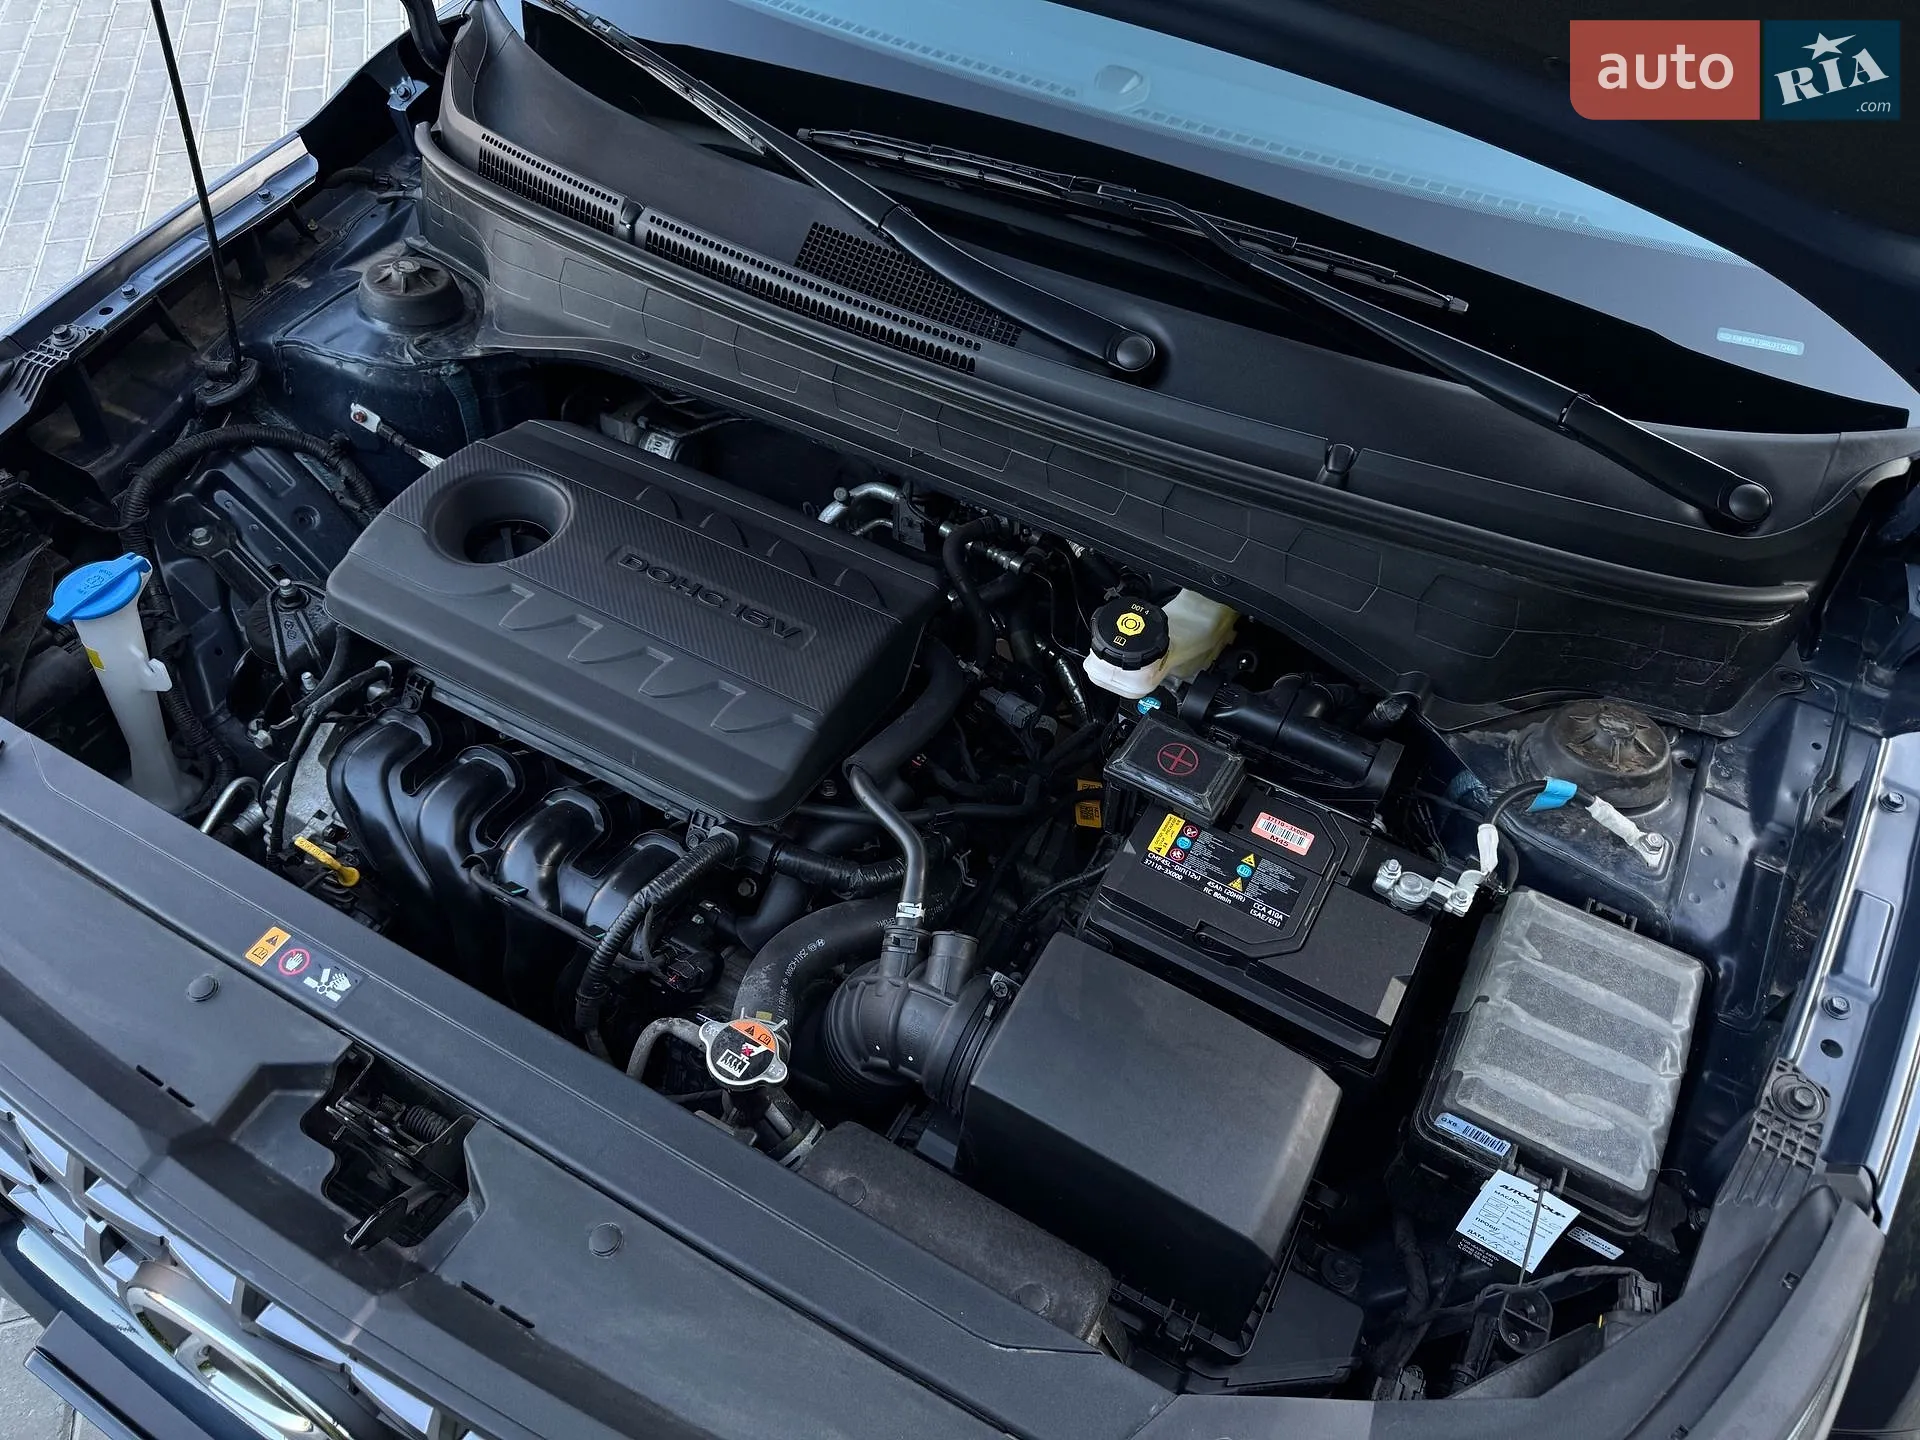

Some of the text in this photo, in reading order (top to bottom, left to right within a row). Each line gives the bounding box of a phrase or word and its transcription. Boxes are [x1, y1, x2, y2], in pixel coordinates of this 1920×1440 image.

[617, 553, 801, 639] DOHC 16V
[1131, 604, 1144, 613] DOT
[1269, 835, 1289, 847] M45
[1203, 886, 1232, 905] RC 80min
[1253, 902, 1283, 921] CCA 410A
[1500, 1184, 1566, 1218] AUTOGOUP
